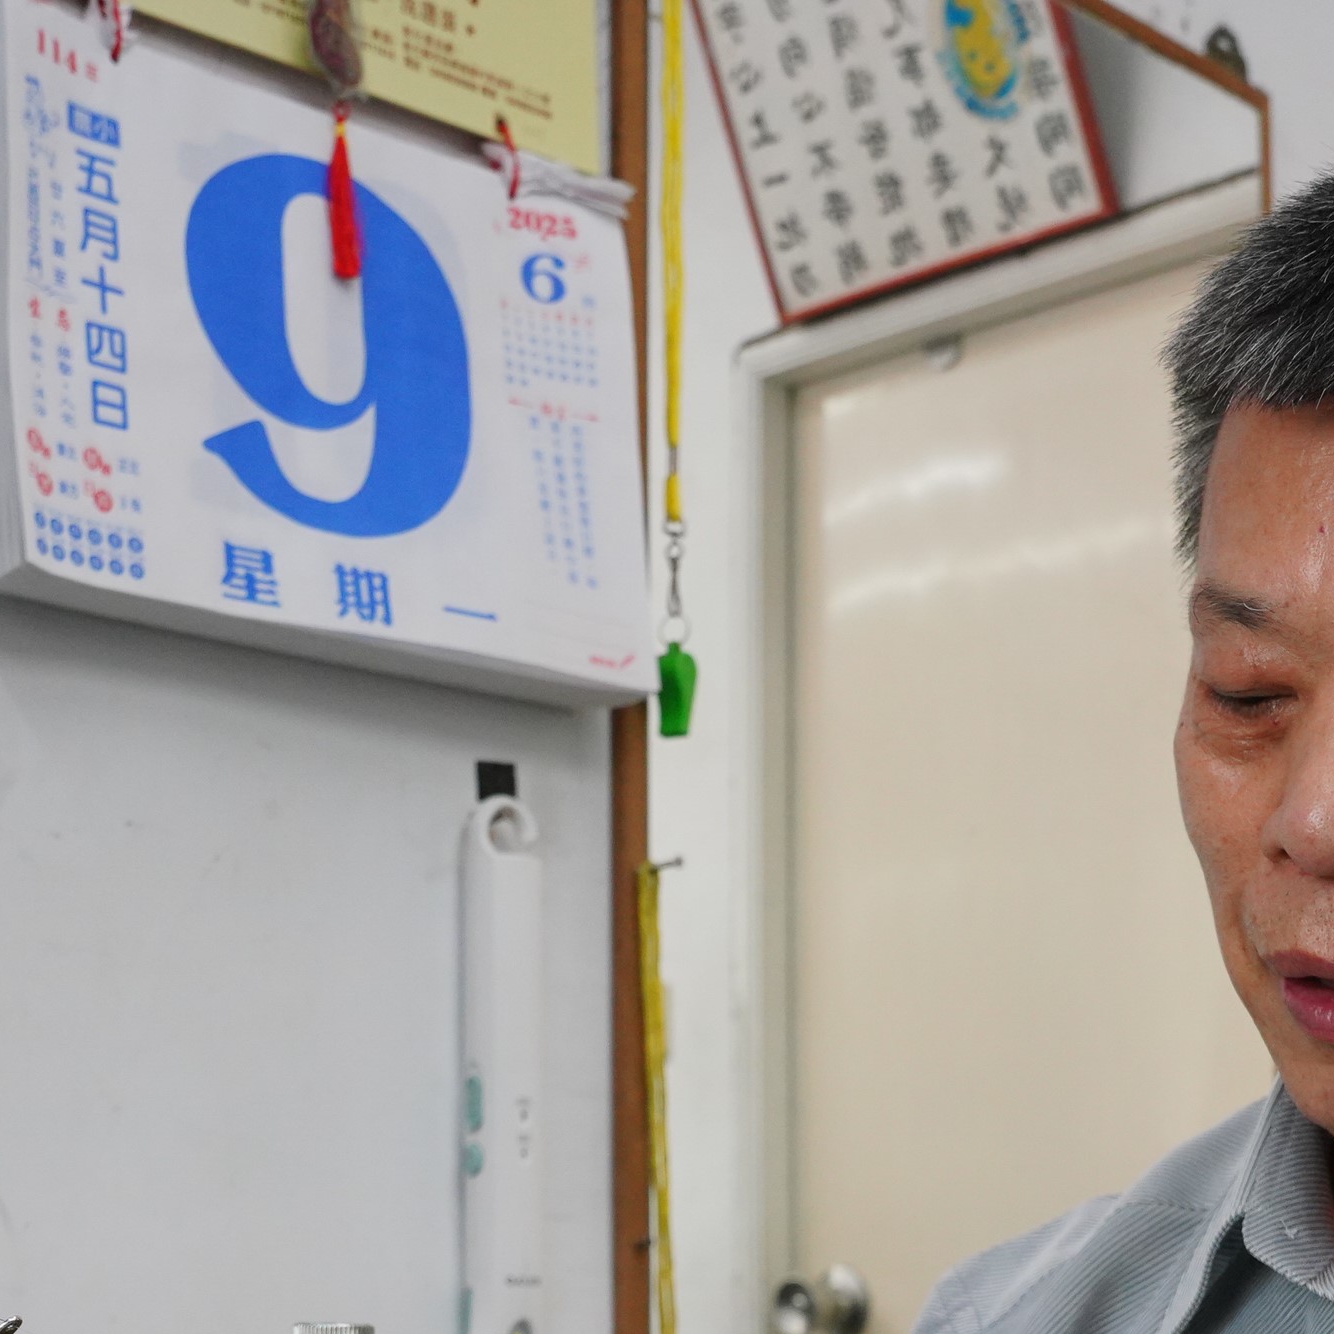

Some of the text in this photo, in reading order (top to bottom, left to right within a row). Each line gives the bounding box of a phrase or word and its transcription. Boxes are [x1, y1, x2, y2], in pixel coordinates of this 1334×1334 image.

[75, 148, 129, 431] 五月十四日
[183, 152, 472, 538] 9
[520, 252, 566, 305] 6
[220, 540, 498, 627] 星期一
